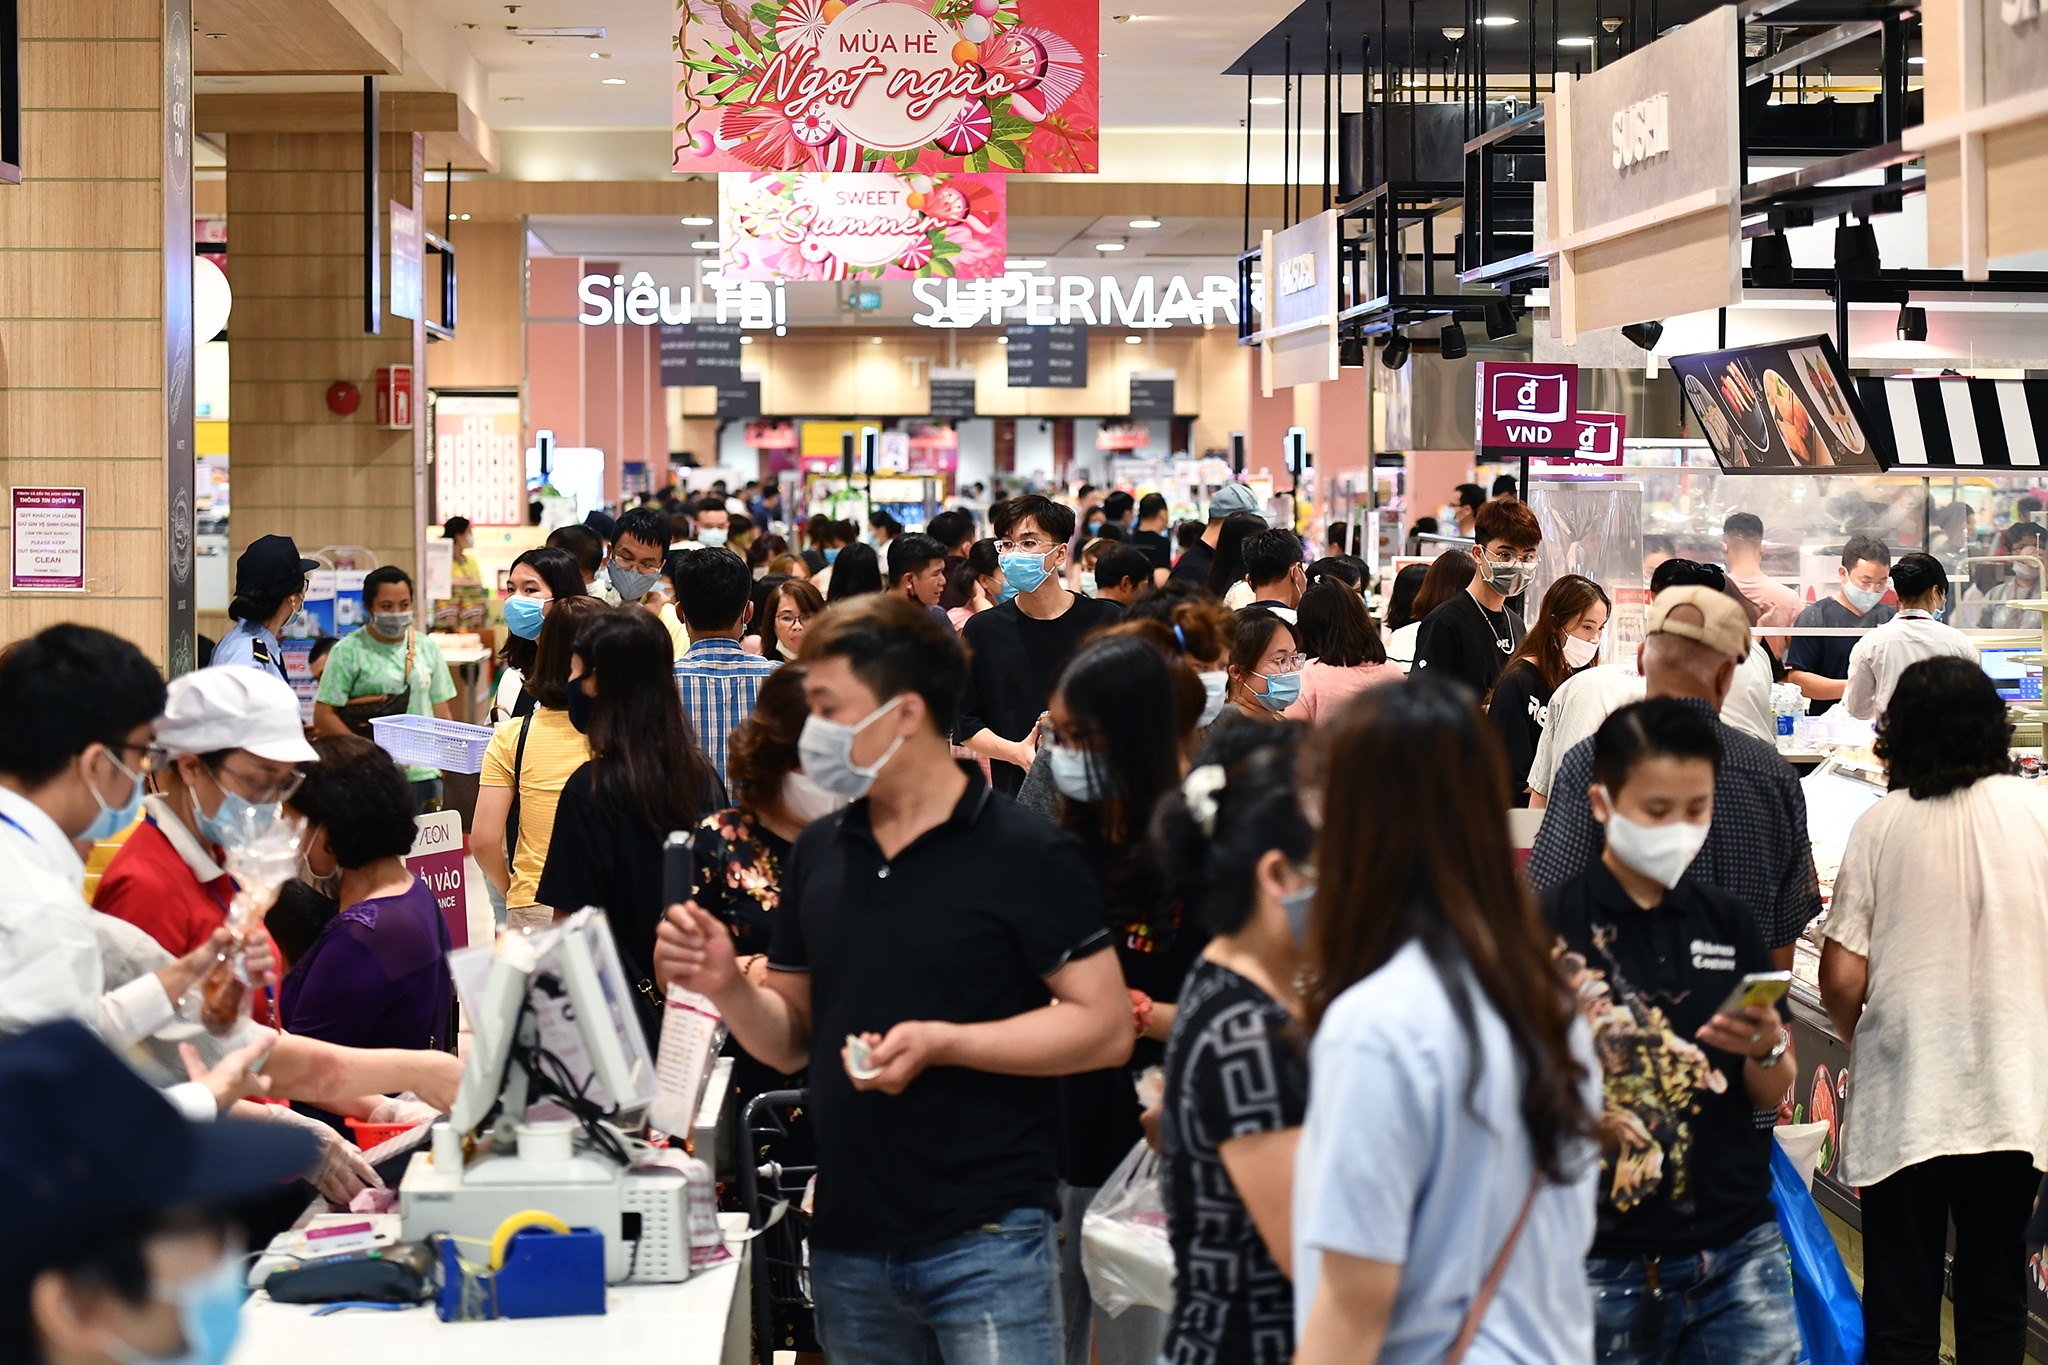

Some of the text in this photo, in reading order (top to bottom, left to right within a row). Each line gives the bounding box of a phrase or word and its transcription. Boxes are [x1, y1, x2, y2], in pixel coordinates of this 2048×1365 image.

[839, 28, 938, 54] MÙA HÈ
[750, 48, 1017, 120] Ngọt ngào
[1611, 92, 1669, 170] SUSHI
[835, 190, 900, 206] SWEET
[779, 200, 948, 243] Summer
[578, 271, 692, 326] Siêu
[911, 274, 1241, 328] SUPERMAR
[1506, 425, 1552, 443] VND
[19, 496, 41, 504] THÔNG
[51, 497, 67, 505] DỊCH
[434, 866, 461, 892] VÀO
